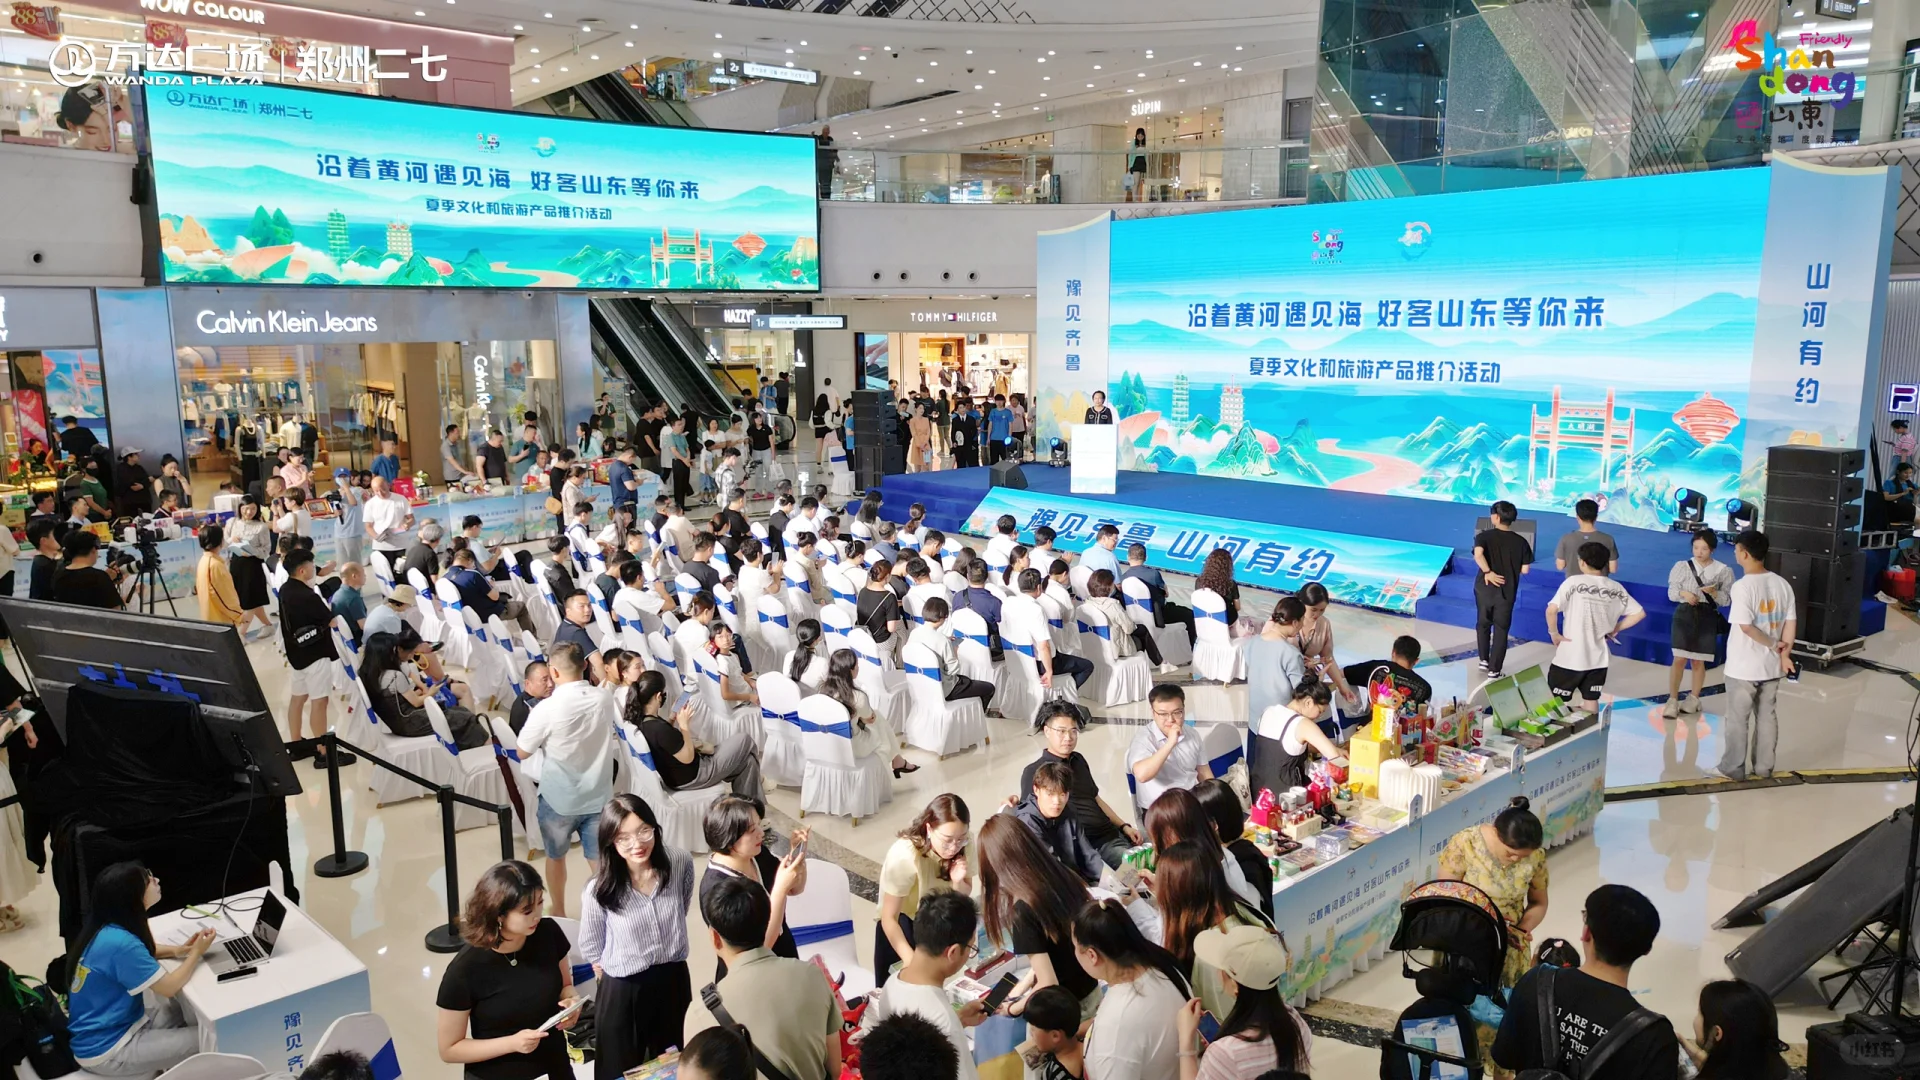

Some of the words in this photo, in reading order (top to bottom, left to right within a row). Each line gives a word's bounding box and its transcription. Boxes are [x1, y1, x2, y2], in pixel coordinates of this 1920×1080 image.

[193, 1, 265, 24] COLOUR
[188, 92, 248, 110] 万达广场
[258, 102, 313, 120] 郑州二七
[316, 153, 511, 189] 沿着黄河遇见海
[530, 170, 699, 199] 好客山东等你来
[425, 197, 612, 220] 夏季文化和旅游产品推介活动
[196, 309, 266, 334] Calvin
[267, 309, 319, 333] Klein
[319, 309, 378, 333] Jeans
[910, 312, 947, 322] TOMMY
[957, 311, 998, 322] HILFIGER
[1187, 300, 1362, 328] 沿着黄河遇见海
[1376, 295, 1605, 328] 好客山东等你来
[1065, 279, 1082, 371] 豫见齐鲁
[1794, 263, 1831, 404] 山河有约
[1249, 356, 1501, 384] 夏季文化和旅游产品推介活动
[297, 628, 318, 644] WOW
[1559, 1021, 1586, 1041] SALT
[1564, 1012, 1589, 1030] ARE
[1591, 1023, 1609, 1037] TH
[1569, 1038, 1590, 1056] THE
